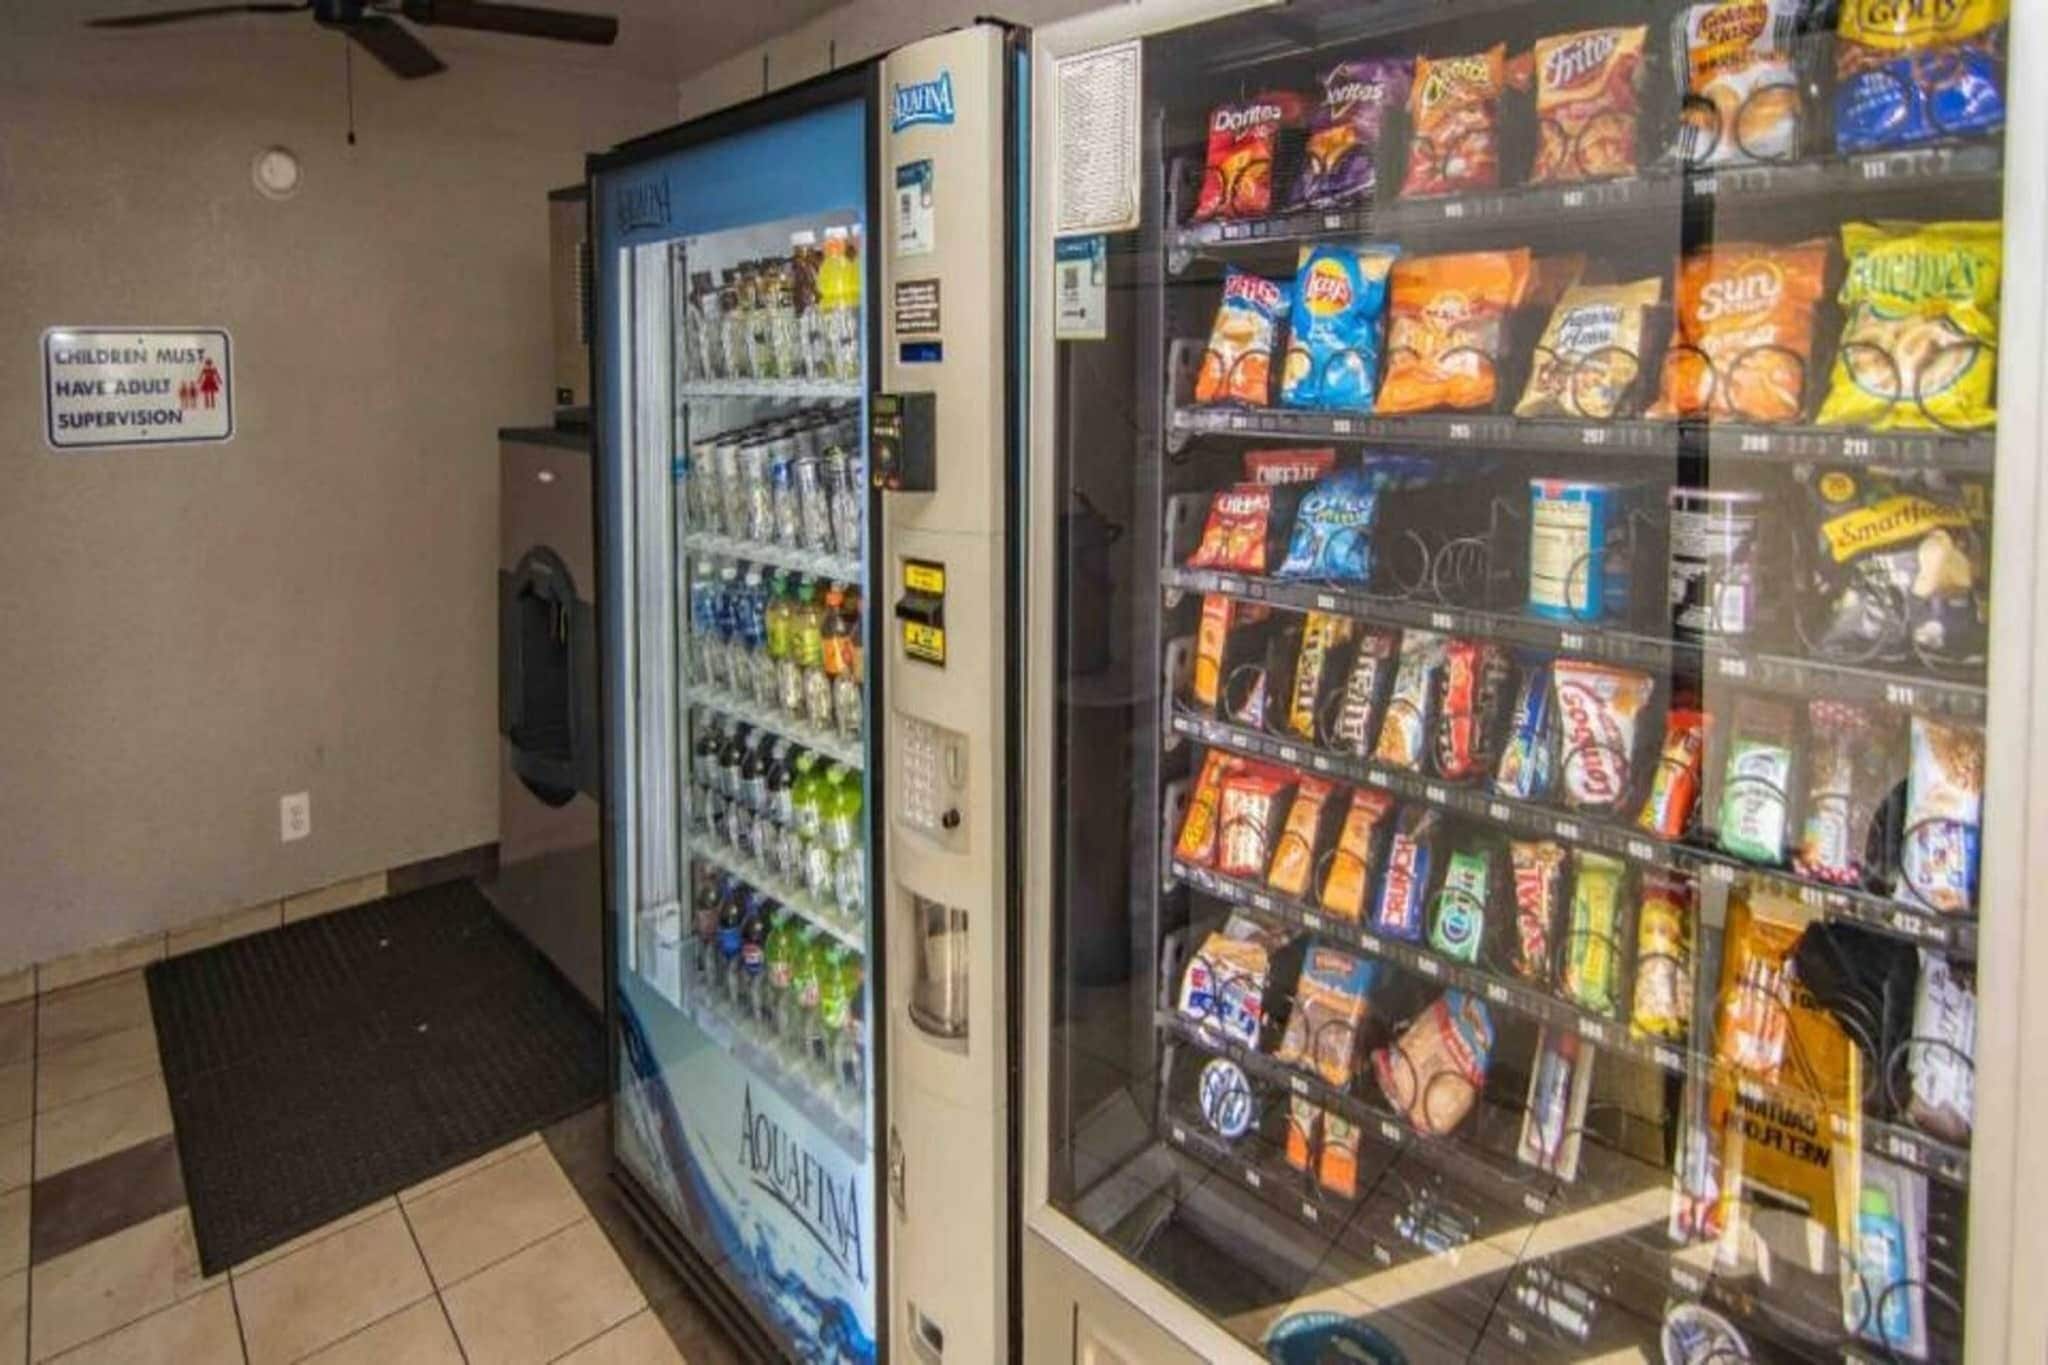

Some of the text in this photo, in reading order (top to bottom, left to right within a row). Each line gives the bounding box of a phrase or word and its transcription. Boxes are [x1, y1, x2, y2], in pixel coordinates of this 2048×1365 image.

[1546, 34, 1615, 86] Fritos
[895, 71, 954, 118] AQUAFINA
[1214, 104, 1281, 131] Doritos
[1696, 271, 1782, 320] Sun
[55, 348, 205, 365] CHILDREN MUST
[56, 379, 171, 397] HAVE ADULT
[58, 409, 183, 430] SUPERVISION
[1844, 438, 1868, 455] 211
[1381, 834, 1418, 930] CRUNCH
[740, 1081, 865, 1284] AQUAFINA
